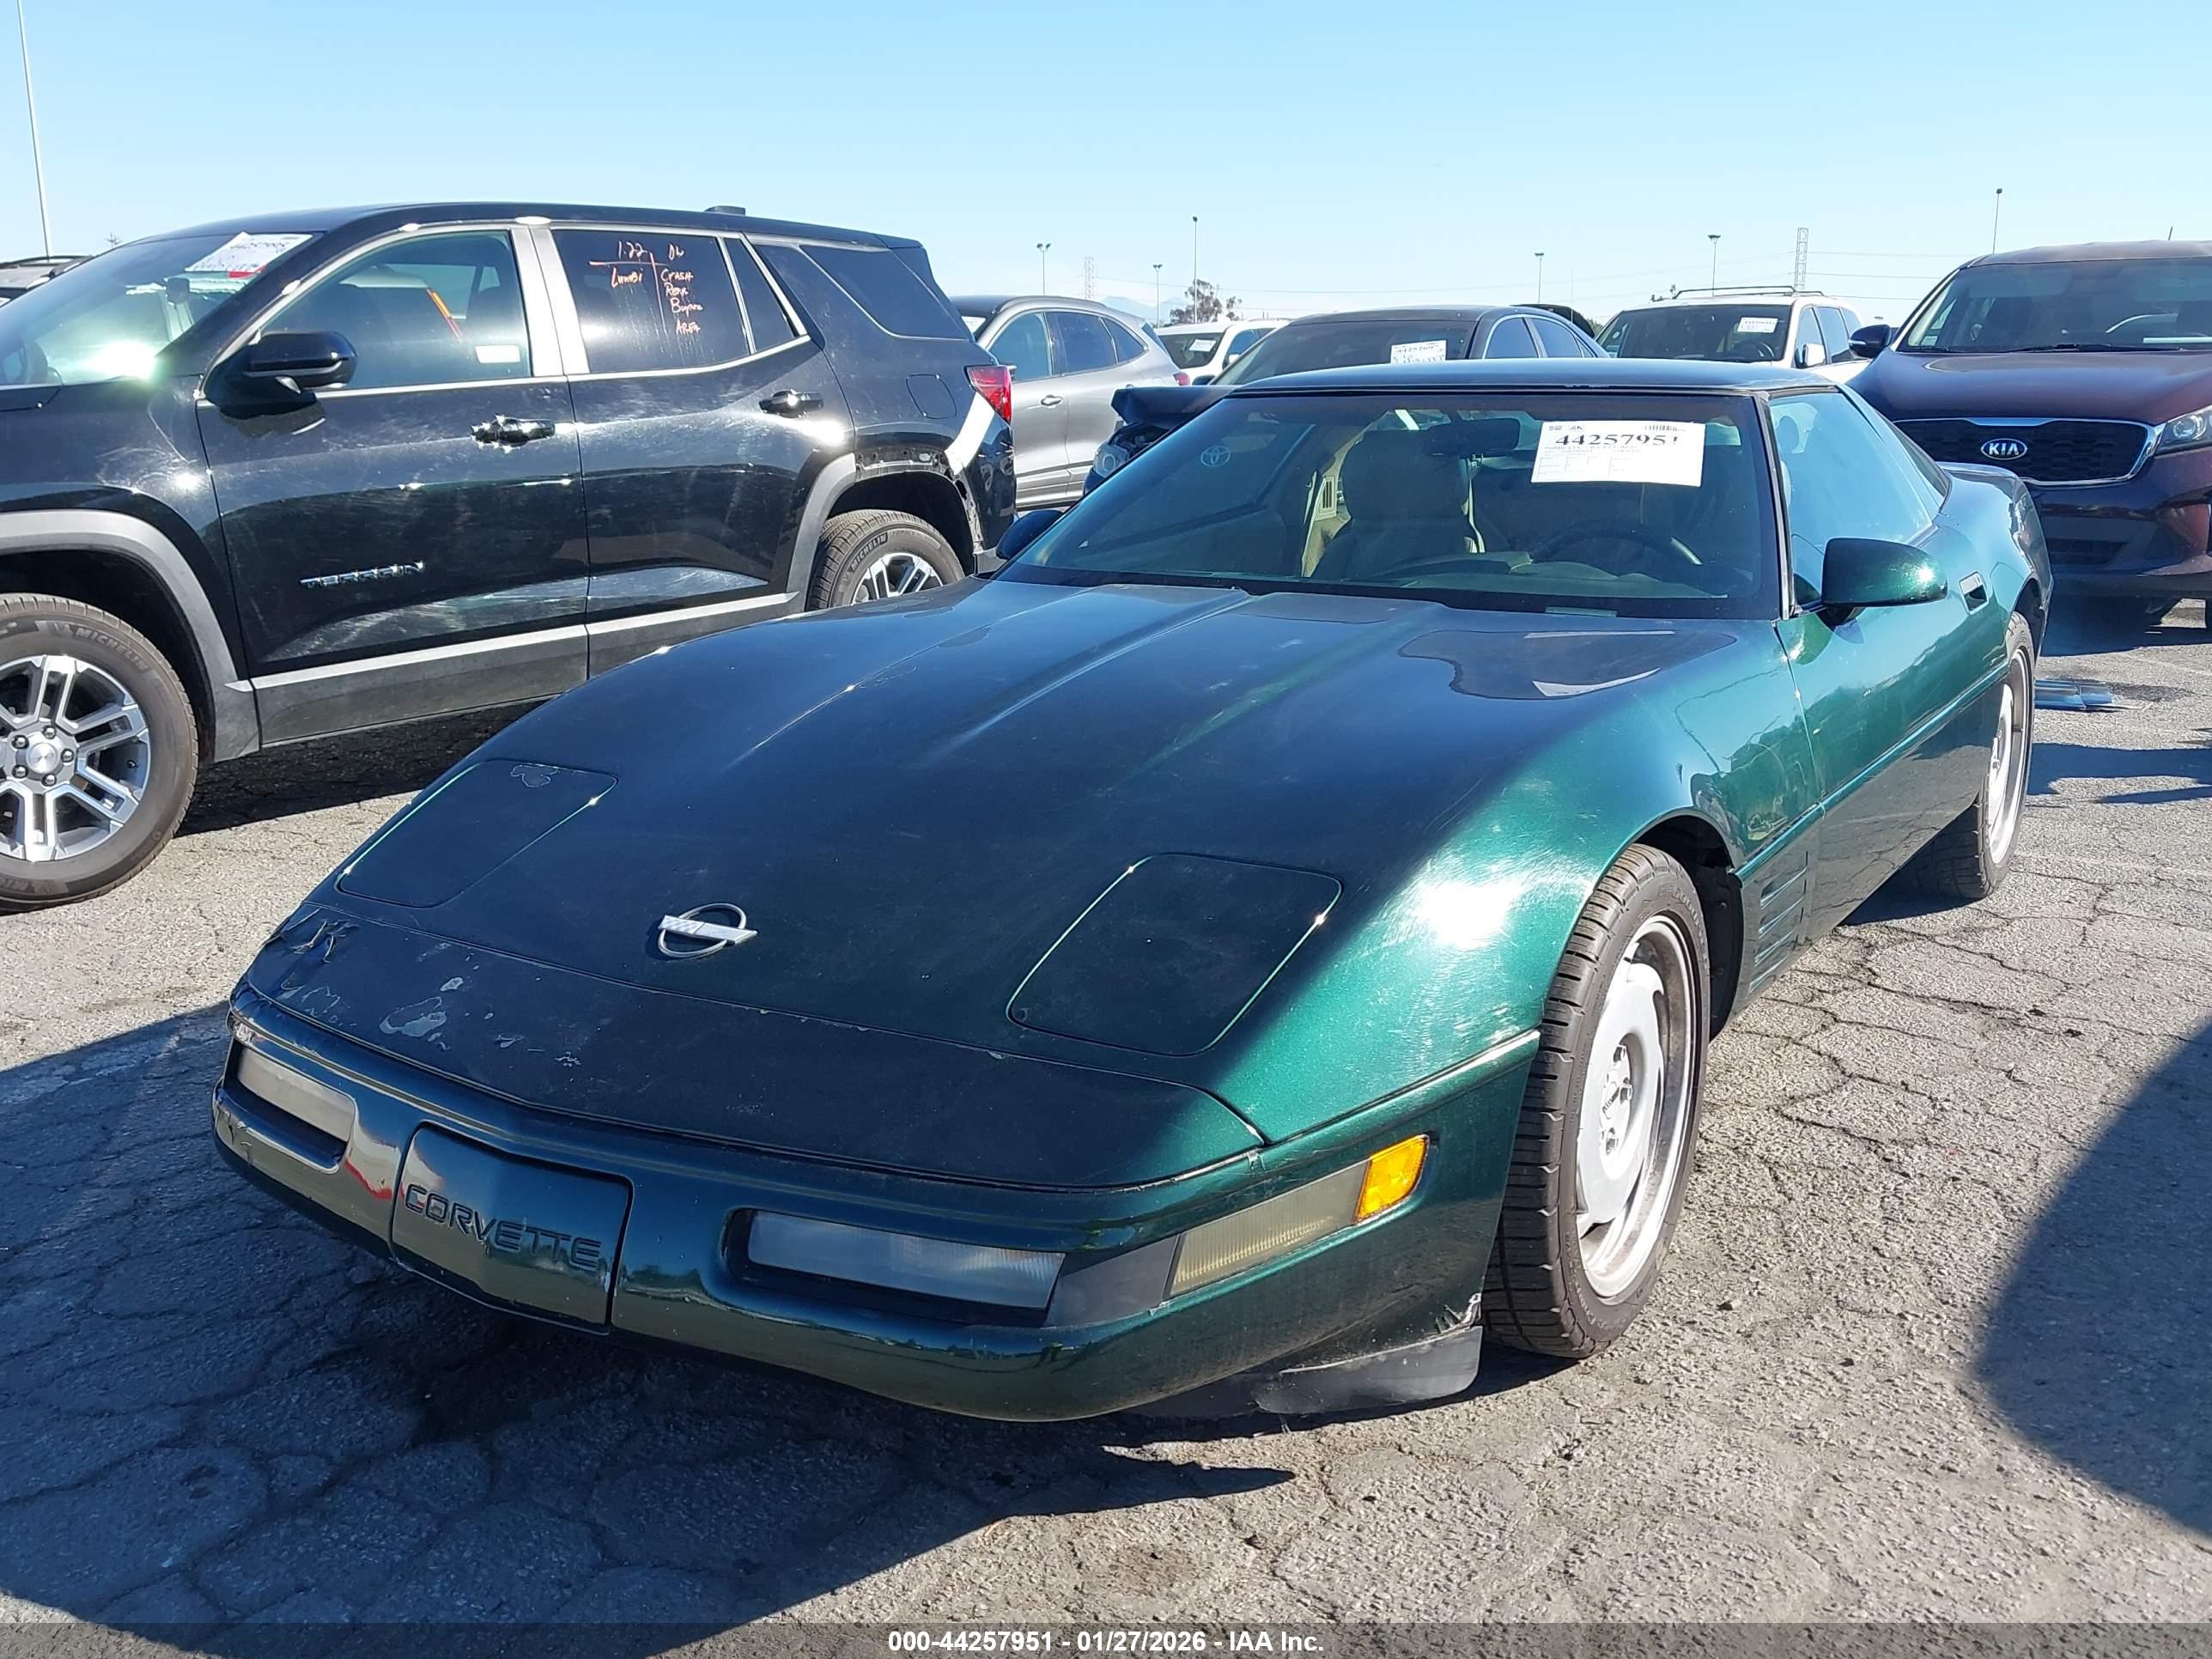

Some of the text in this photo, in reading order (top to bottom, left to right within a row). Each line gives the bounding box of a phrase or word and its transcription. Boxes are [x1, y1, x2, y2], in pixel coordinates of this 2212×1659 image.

[1988, 442, 2020, 457] KIA
[851, 532, 888, 572] MICHELIN
[300, 561, 425, 588] TERRAIN
[74, 627, 149, 673] MICHELIN
[404, 1183, 602, 1272] CORVETTE
